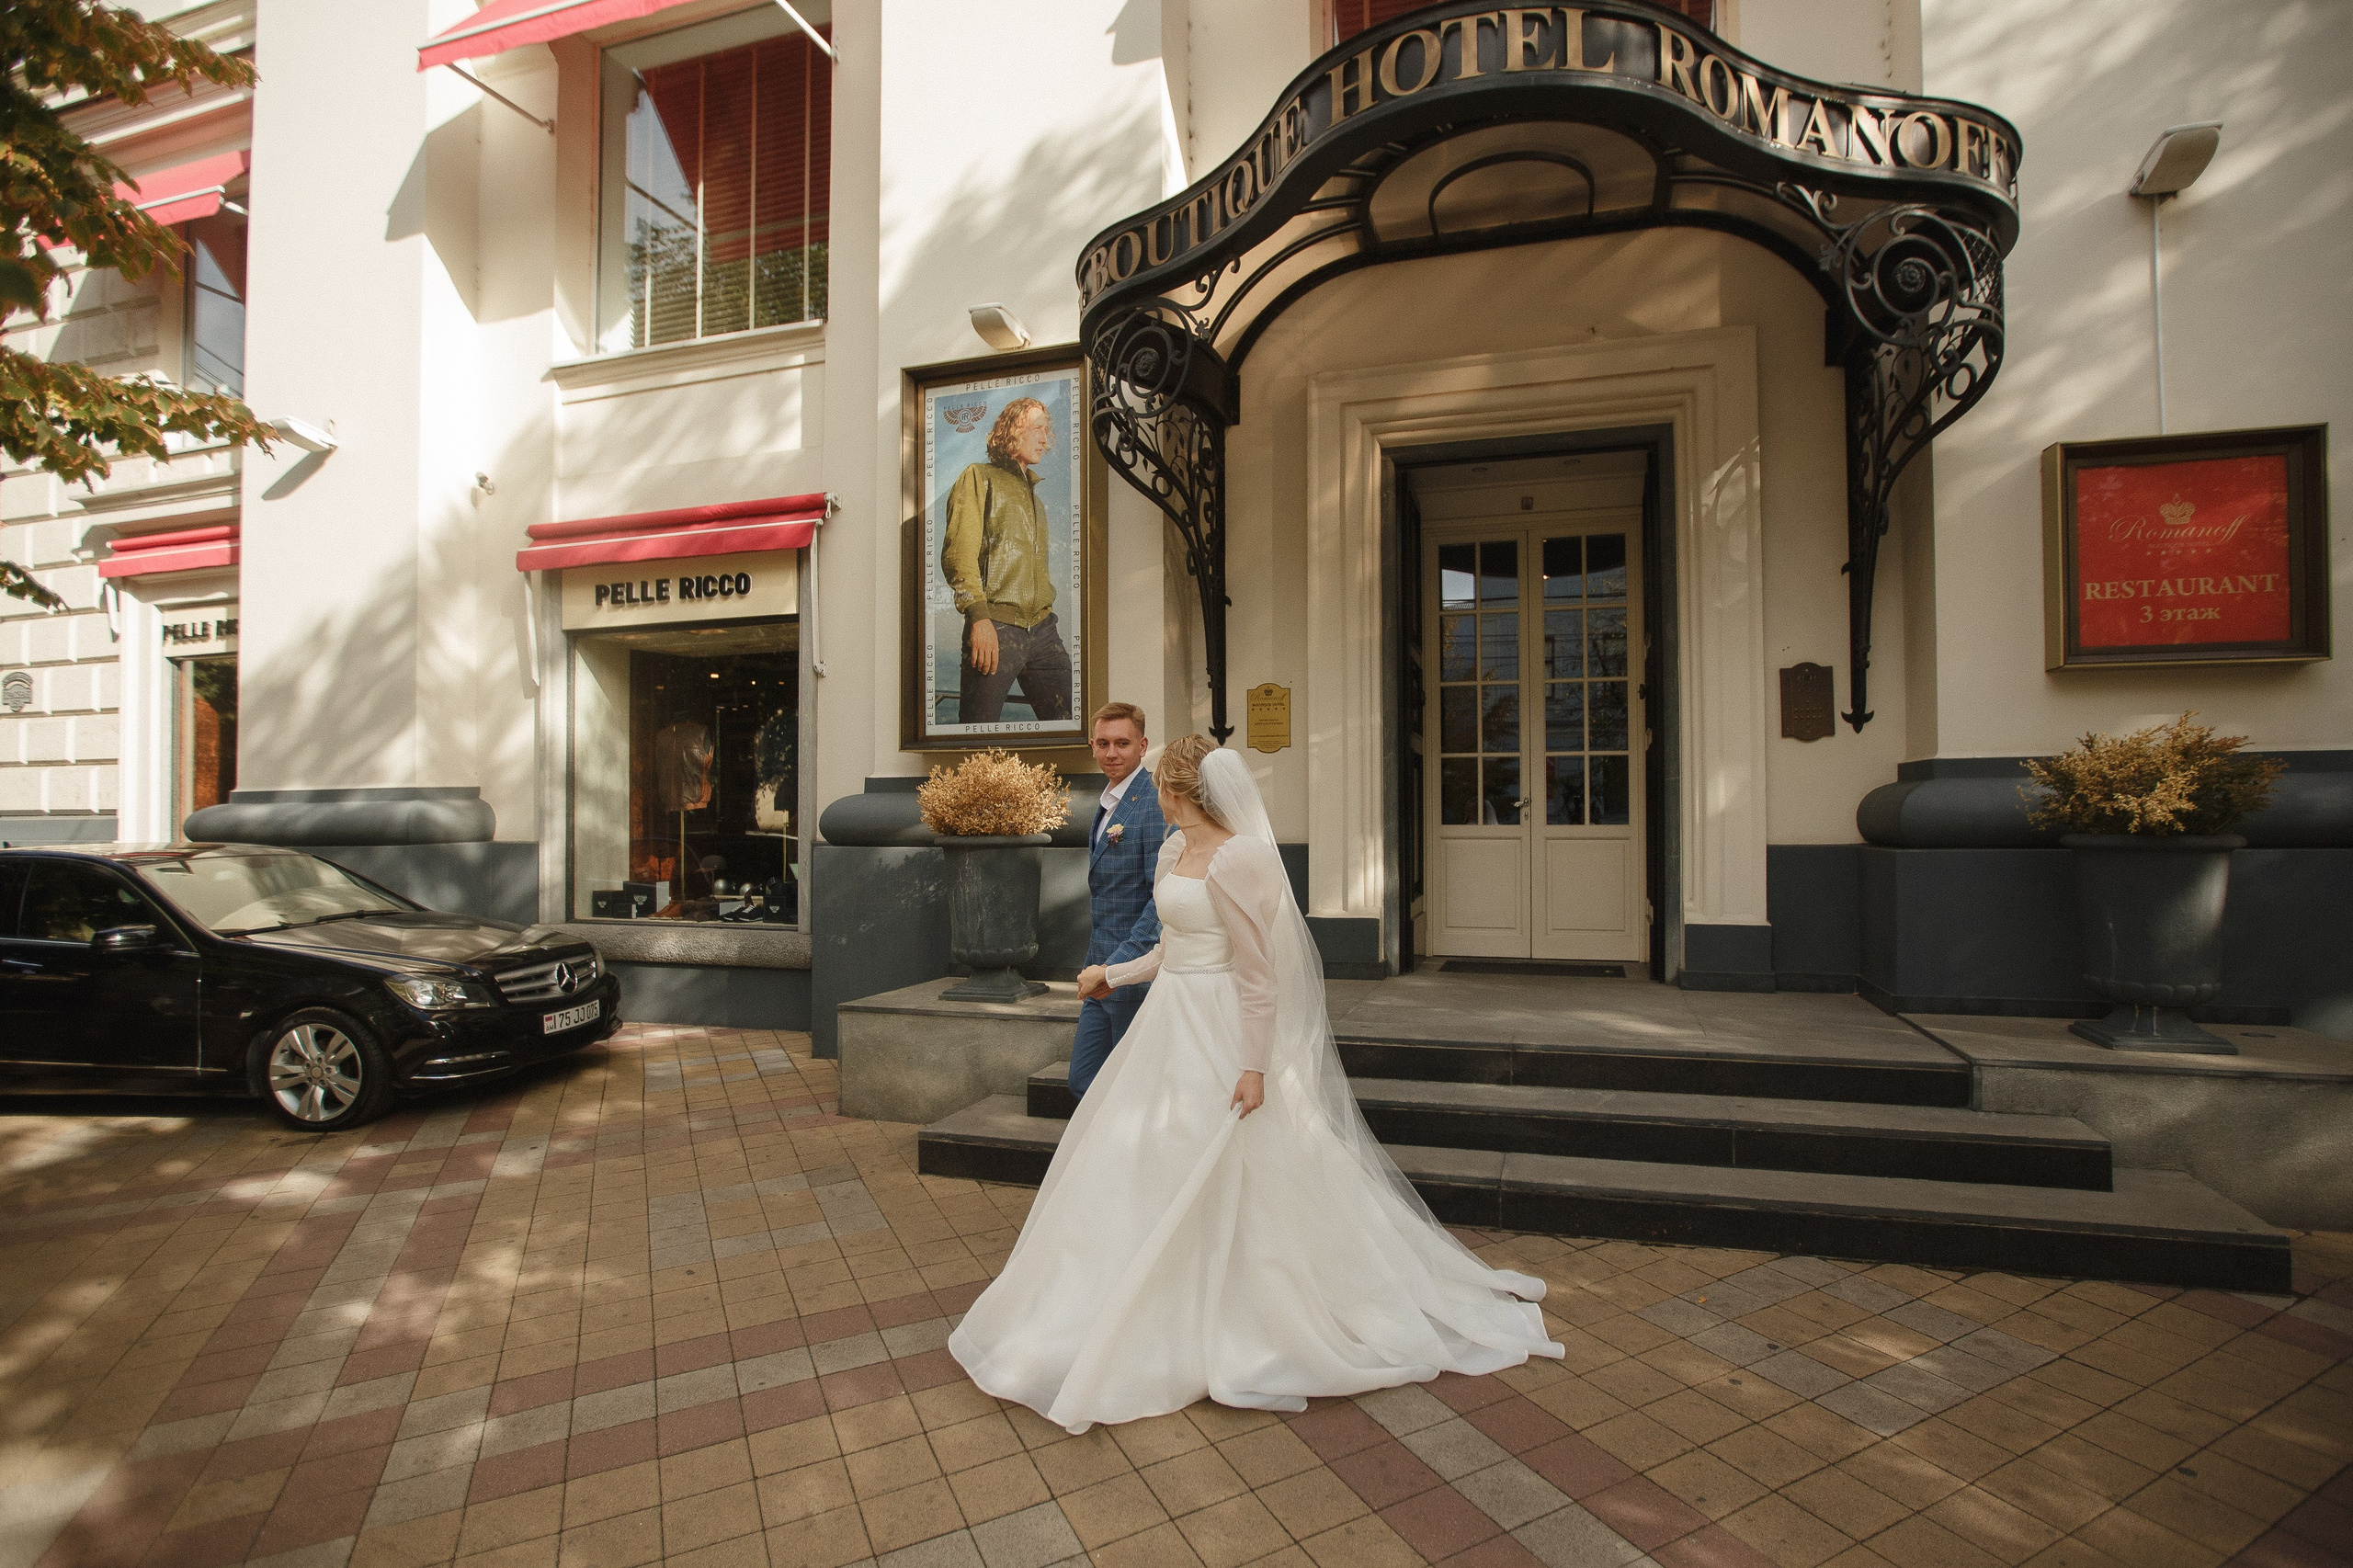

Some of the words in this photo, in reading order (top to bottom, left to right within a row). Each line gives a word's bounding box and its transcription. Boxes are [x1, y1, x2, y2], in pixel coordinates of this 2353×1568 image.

[1089, 97, 1306, 296] BOUTIQUE
[1324, 7, 1615, 130] HOTEL
[1655, 22, 2008, 184] ROMANOFF
[966, 378, 999, 392] PELLE
[1006, 374, 1040, 386] RICCO
[2109, 514, 2250, 545] Romanoff
[596, 578, 671, 607] PELLE
[679, 572, 752, 600] RICCO
[2085, 574, 2279, 600] RESTAURANT
[2140, 605, 2154, 623] 3
[2160, 606, 2221, 621] этаж
[163, 621, 211, 642] PELLE
[965, 724, 999, 733] PELLE
[1006, 722, 1040, 732] RICCO
